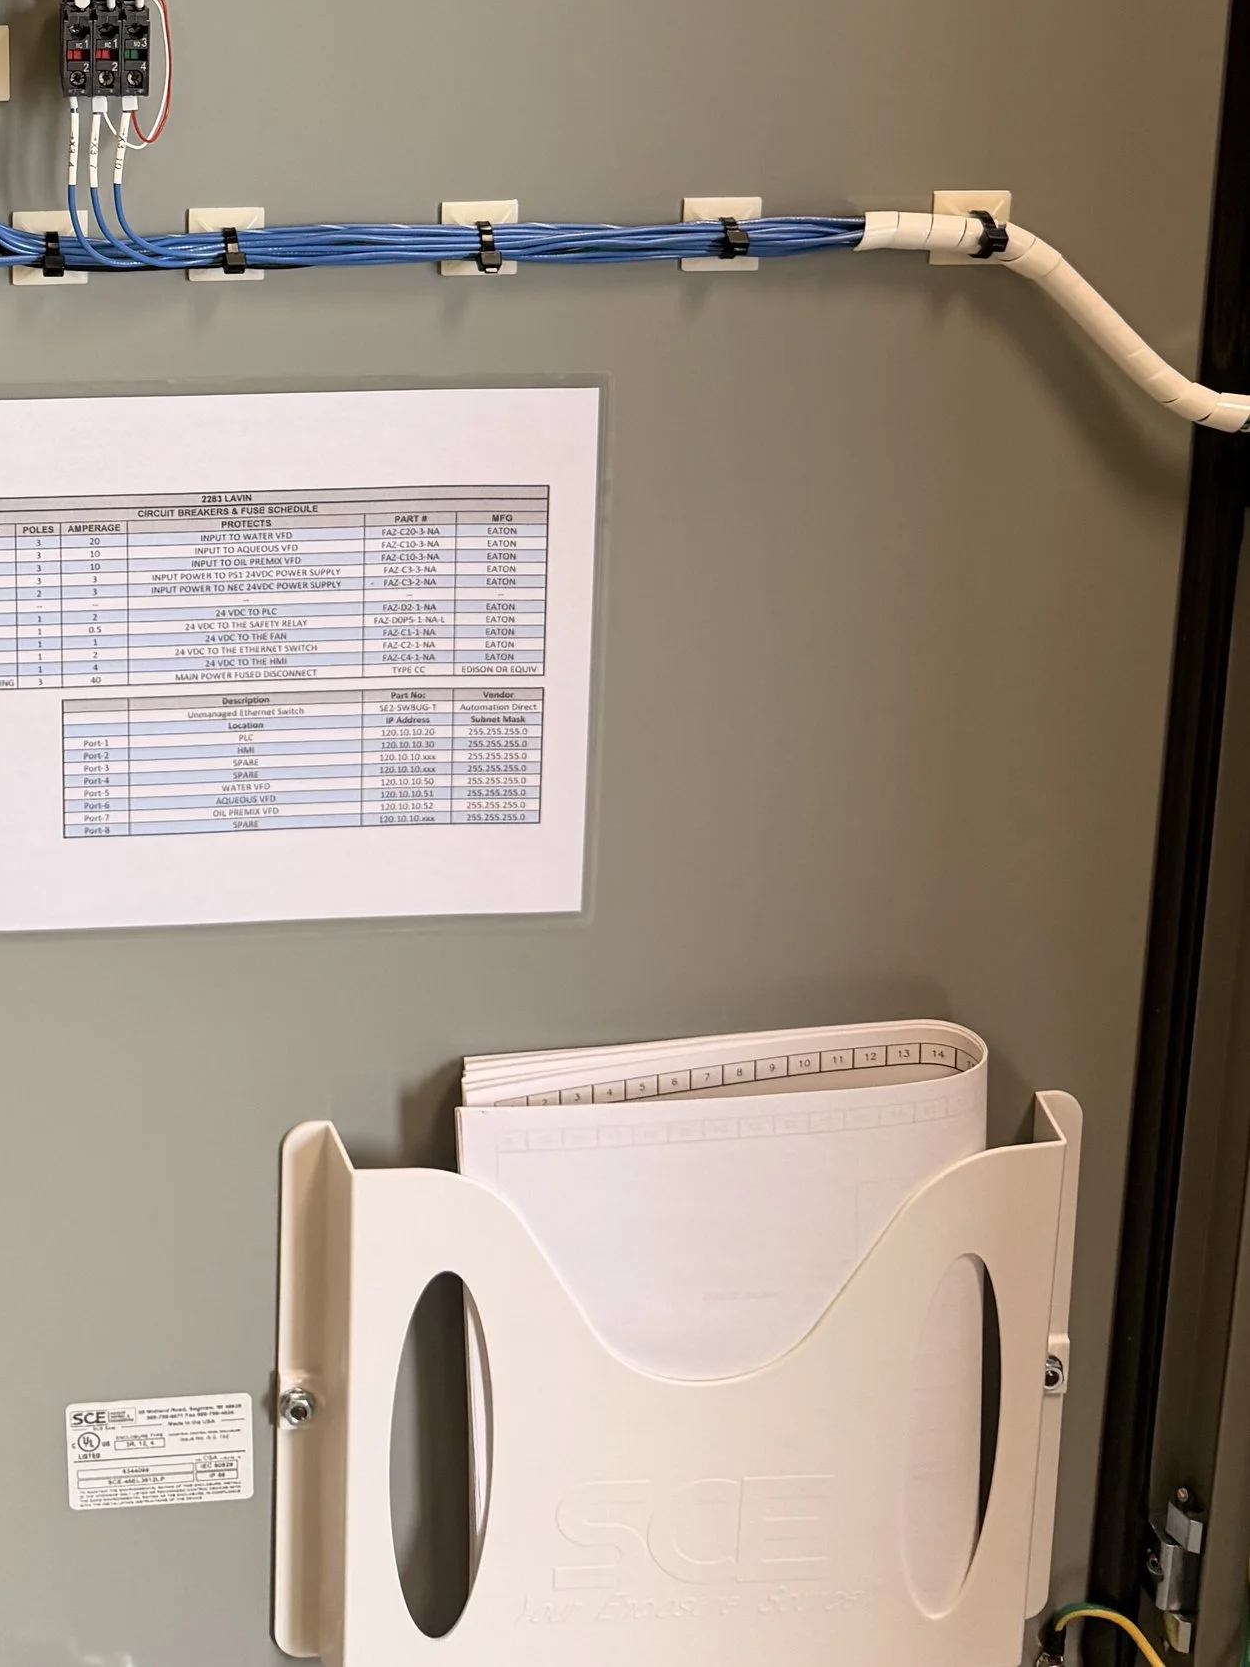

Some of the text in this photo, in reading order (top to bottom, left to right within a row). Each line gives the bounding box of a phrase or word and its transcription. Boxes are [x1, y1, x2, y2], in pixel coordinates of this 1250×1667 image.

[114, 40, 118, 48] 1
[142, 38, 147, 47] 3
[83, 64, 89, 72] 2
[112, 62, 118, 71] 2
[140, 62, 146, 70] 4
[137, 509, 174, 517] CIRCUIT
[178, 507, 229, 516] BREAKERS
[241, 506, 264, 514] FUSE
[267, 504, 318, 514] SCHEDULE
[394, 514, 418, 523] PART
[492, 514, 512, 522] MFG
[67, 523, 120, 532] AMPERAGE
[221, 519, 271, 528] PROTECTS
[22, 525, 54, 534] POLES
[381, 527, 440, 536] FAZ-C20-3-NA
[487, 526, 517, 535] EATON
[242, 532, 273, 540] WATER
[89, 537, 100, 545] 20
[381, 540, 439, 548] FAZ-C10-3-NA
[487, 539, 516, 548] EATON
[194, 546, 220, 554] INPUT
[236, 544, 279, 553] AQUEOUS
[90, 550, 100, 558] 10
[381, 552, 440, 561] FAZ-C10-3-NA
[487, 552, 516, 560] EATON
[383, 565, 436, 574] FAZ-C3-3-NA
[486, 564, 516, 573] EATON
[383, 577, 436, 586] FAZ-C3-2-NA
[486, 577, 516, 585] EATON
[382, 603, 436, 611] FAZ-D2-1-NA
[486, 602, 515, 611] EATON
[485, 614, 515, 623] EATON
[382, 628, 436, 636] FAZ-C1-1-NA
[485, 627, 514, 636] EATON
[382, 640, 435, 649] FAZ-C2-1-NA
[485, 640, 514, 648] EATON
[382, 653, 435, 661] FAZ-C4-1-NA
[485, 652, 514, 660] EATON
[263, 669, 316, 678] DISCONNECT
[392, 666, 411, 674] TYPE
[461, 665, 493, 673] EDISON
[510, 665, 537, 673] EQUIV
[482, 690, 514, 698] Vendor
[222, 695, 270, 705] Description
[459, 702, 536, 711] Automation Direct
[187, 709, 237, 719] Unmanaged
[239, 708, 275, 716] Ethernet
[396, 715, 430, 724] Address
[470, 715, 525, 723] Subnet Mask
[228, 721, 264, 729] Location
[381, 728, 435, 737] 120.10.10.20
[468, 726, 528, 736] 255.255.255.0
[381, 740, 434, 749] 120.10.10.30
[467, 738, 527, 748] 255.255.255.0
[83, 751, 108, 760] Port-2
[467, 751, 527, 761] 255.255.255.0
[83, 764, 109, 772] Port-3
[381, 777, 434, 786] 120.10.10.50
[467, 775, 526, 785] 255.255.255.0
[84, 788, 109, 797] Port-5
[381, 789, 433, 798] 120.10.10.51
[466, 787, 526, 799] 255.255.255.0
[84, 801, 110, 809] Port-6
[380, 801, 433, 811] 120.10.10.52
[466, 800, 525, 810] 255.255.255.0
[84, 813, 109, 822] Port-7
[704, 1073, 710, 1081] 7
[769, 1064, 775, 1072] 9
[799, 1059, 811, 1068] 10
[832, 1056, 843, 1064] 11
[865, 1053, 876, 1061] 12
[898, 1050, 910, 1058] 13
[932, 1050, 945, 1058] 14
[73, 1412, 106, 1425] SCE
